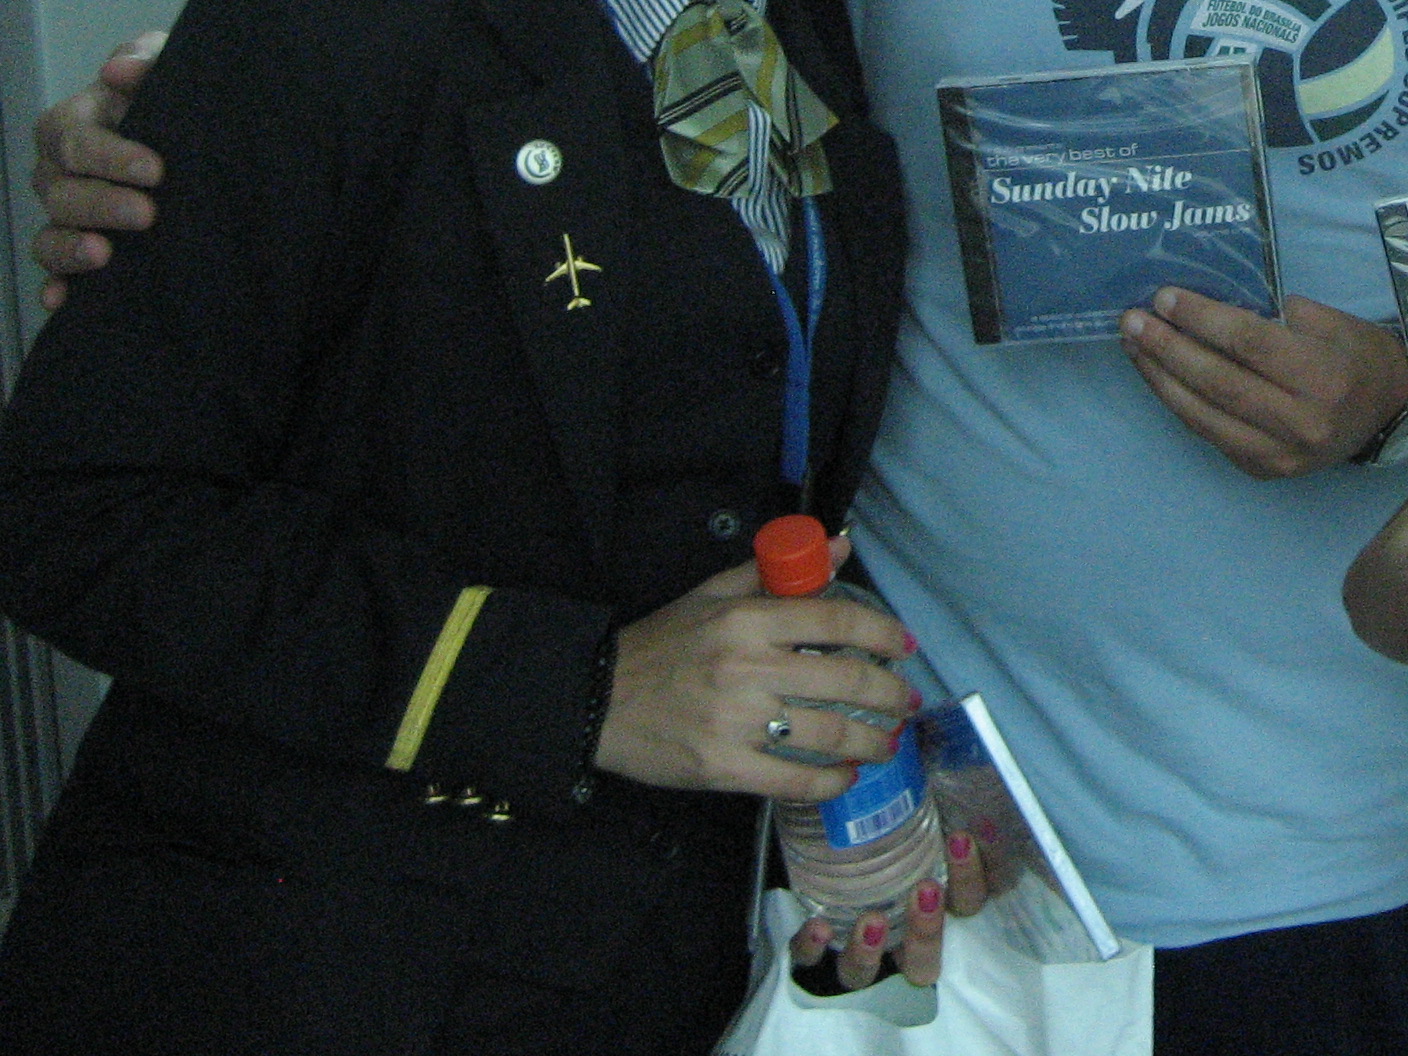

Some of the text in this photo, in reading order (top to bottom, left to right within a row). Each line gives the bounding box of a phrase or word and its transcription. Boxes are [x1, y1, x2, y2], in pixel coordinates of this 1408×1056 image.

[1201, 12, 1300, 44] JOGOS NACIONALS
[1249, 4, 1262, 17] DO
[1262, 7, 1302, 34] BRASILIA
[987, 155, 1020, 168] the
[1022, 151, 1066, 166] very
[1069, 146, 1116, 162] best
[1119, 143, 1139, 158] of
[990, 164, 1193, 204] Sunday Nite
[1079, 200, 1251, 235] Slow Jams
